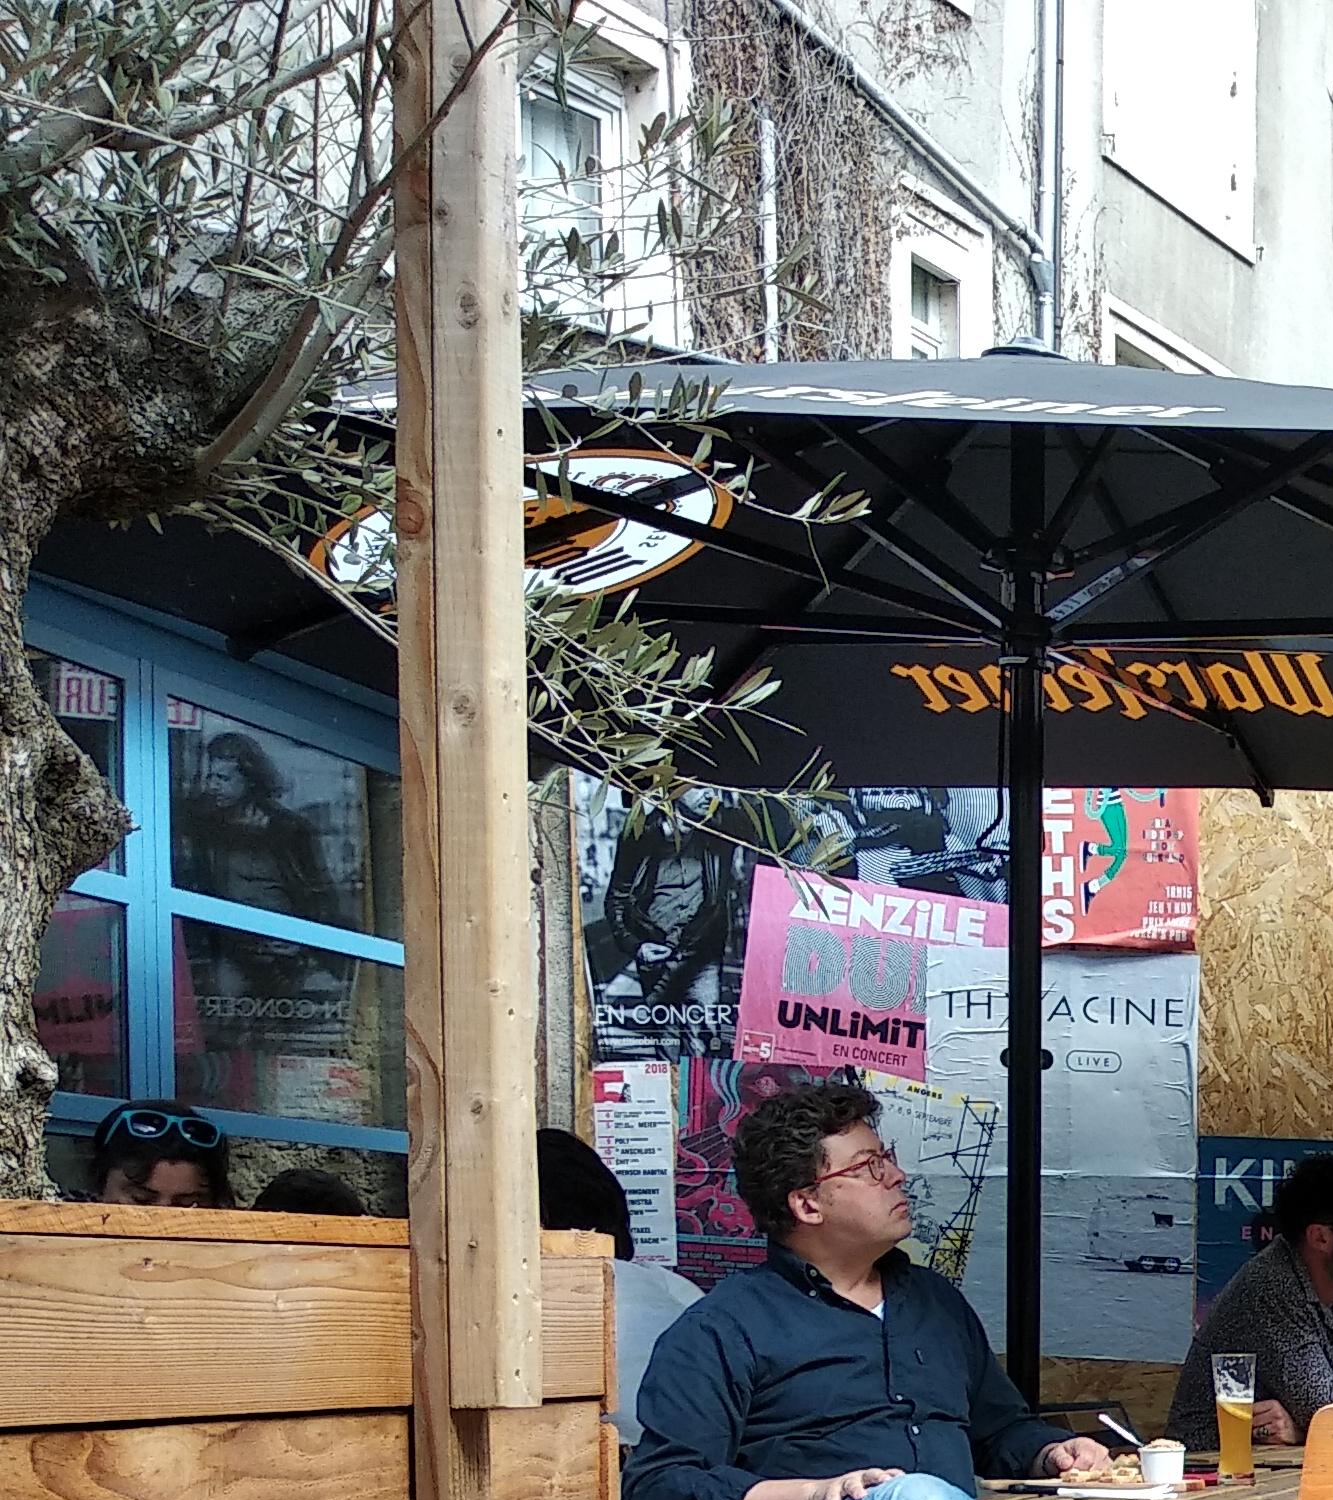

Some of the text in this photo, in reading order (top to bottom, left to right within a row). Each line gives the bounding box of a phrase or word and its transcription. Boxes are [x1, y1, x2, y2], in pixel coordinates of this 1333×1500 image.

[593, 1004, 626, 1025] EN
[832, 1044, 849, 1058] EN
[852, 1046, 908, 1067] CONCERT
[1077, 1056, 1111, 1068] LIVE
[644, 1063, 668, 1074] 2018
[906, 1085, 943, 1100] ANGERS
[1241, 1225, 1273, 1241] EN
